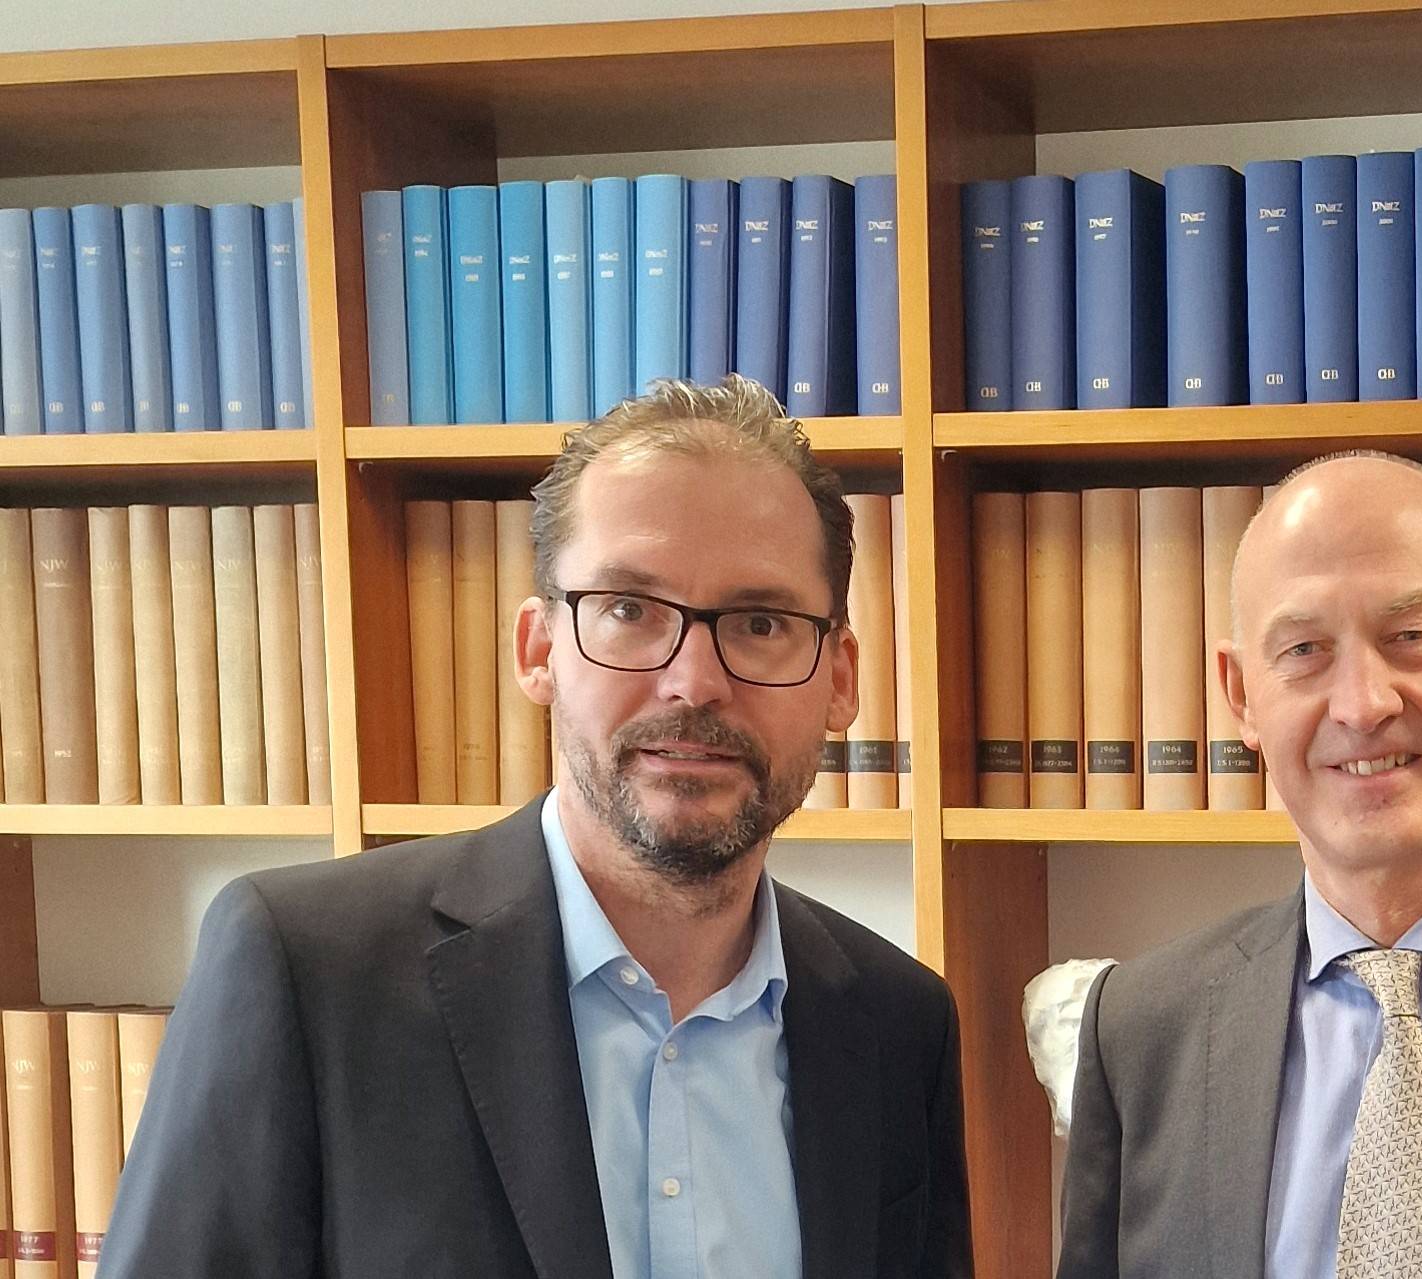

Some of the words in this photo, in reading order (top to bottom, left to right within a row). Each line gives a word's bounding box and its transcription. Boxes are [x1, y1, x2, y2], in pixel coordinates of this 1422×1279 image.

[39, 559, 69, 574] NJW
[1162, 745, 1182, 754] 1964
[1223, 745, 1244, 754] 1965
